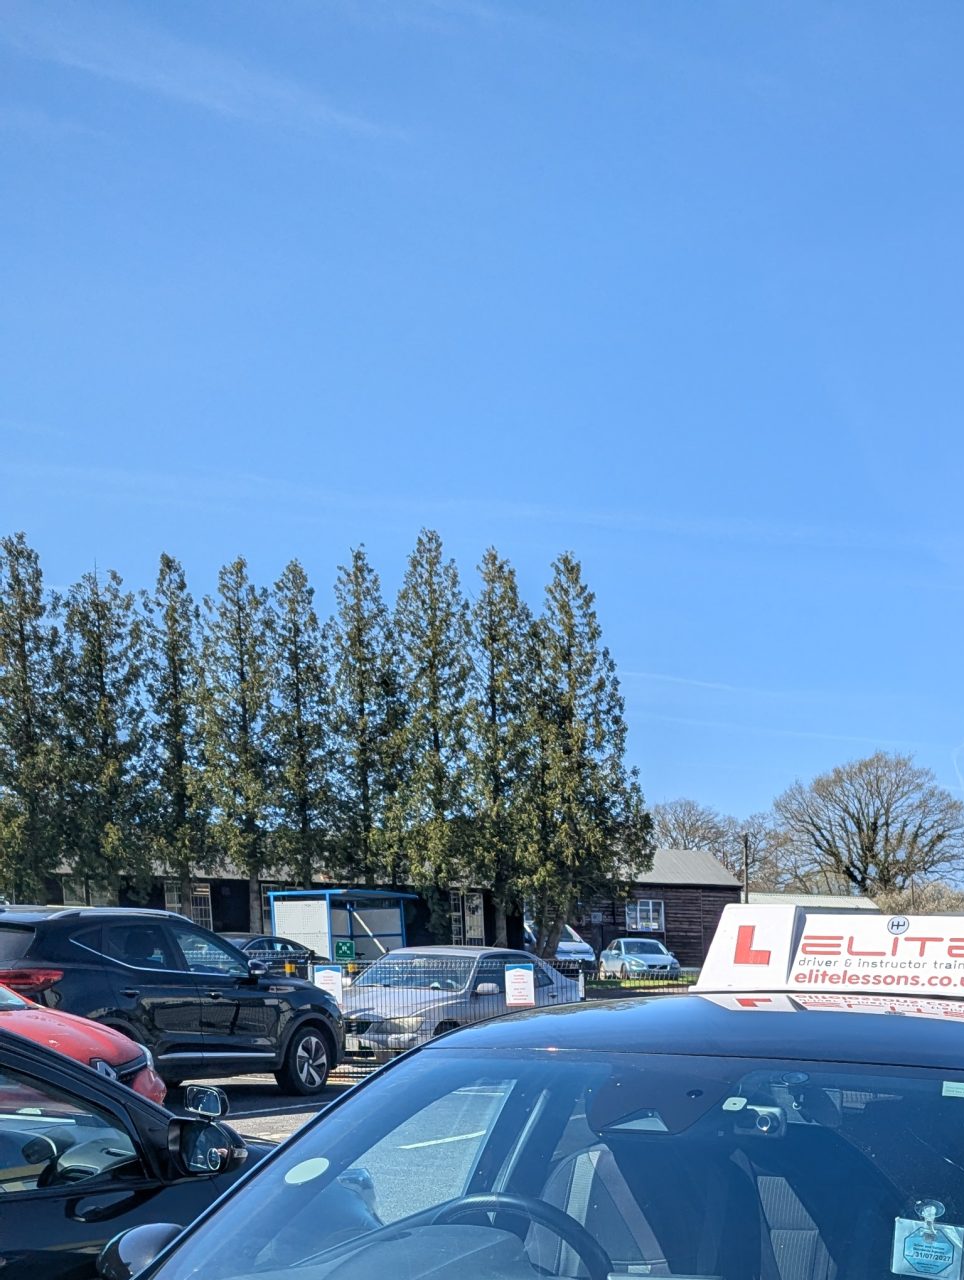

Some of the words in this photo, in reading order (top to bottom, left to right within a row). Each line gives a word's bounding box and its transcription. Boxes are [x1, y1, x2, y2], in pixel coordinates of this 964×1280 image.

[733, 925, 771, 966] L
[798, 957, 839, 967] driver
[844, 958, 852, 968] &
[857, 958, 928, 969] instructor
